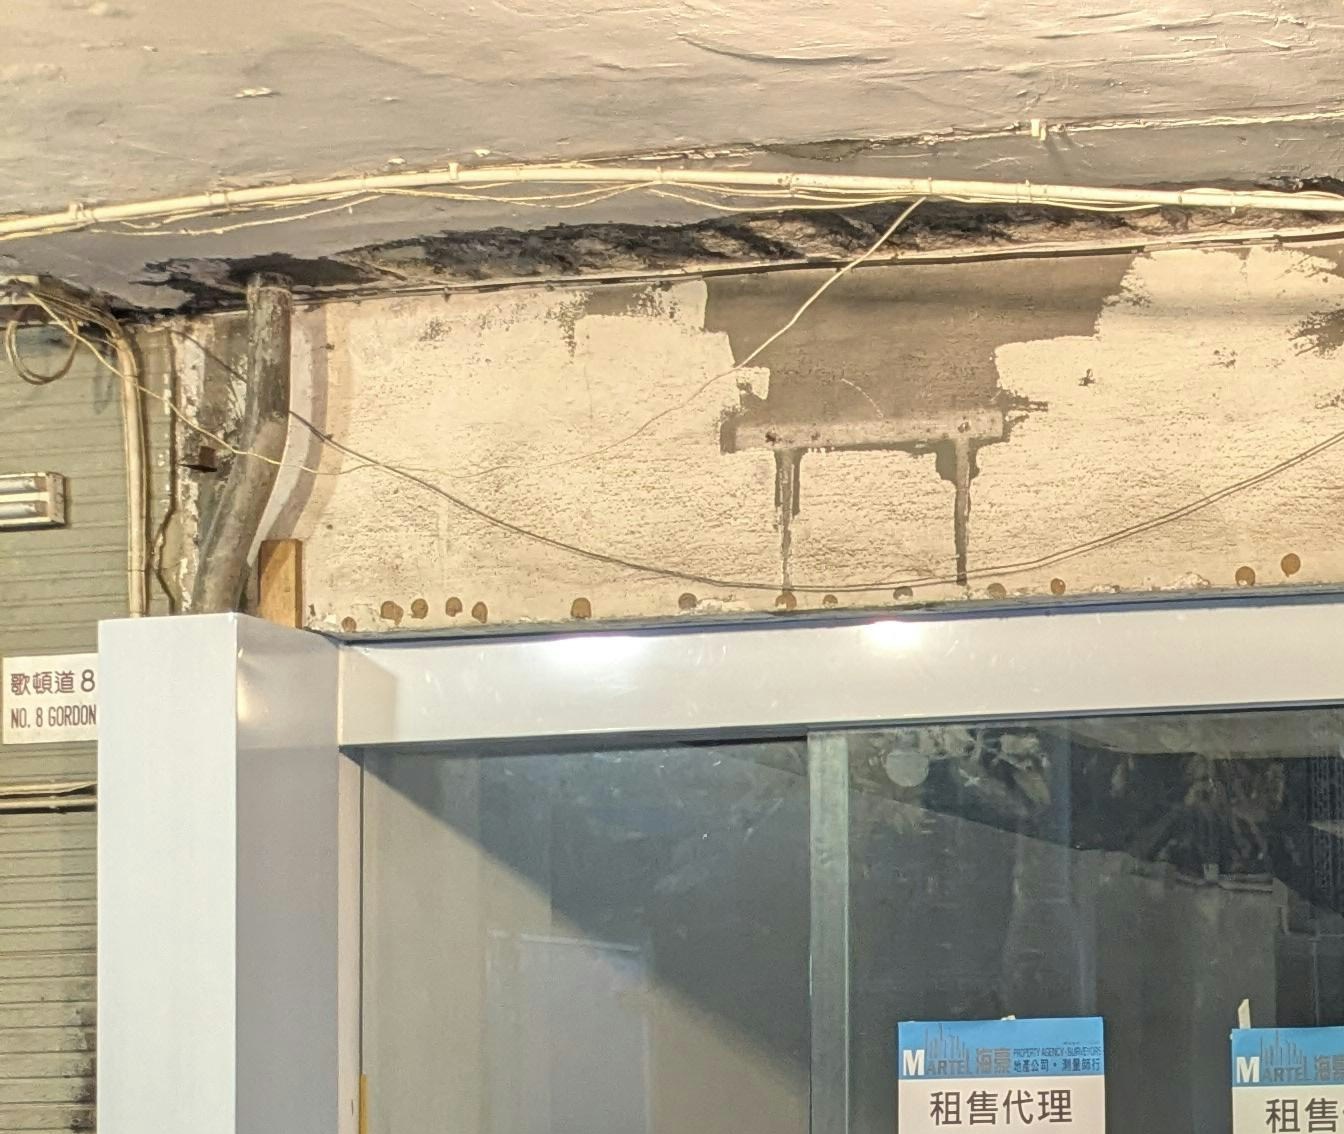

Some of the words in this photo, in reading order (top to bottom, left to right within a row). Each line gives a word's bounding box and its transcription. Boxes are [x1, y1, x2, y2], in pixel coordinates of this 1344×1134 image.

[11, 707, 31, 729] NO.
[36, 707, 43, 727] 8
[48, 704, 97, 727] GORDON
[930, 1089, 1073, 1126] 租售代理
